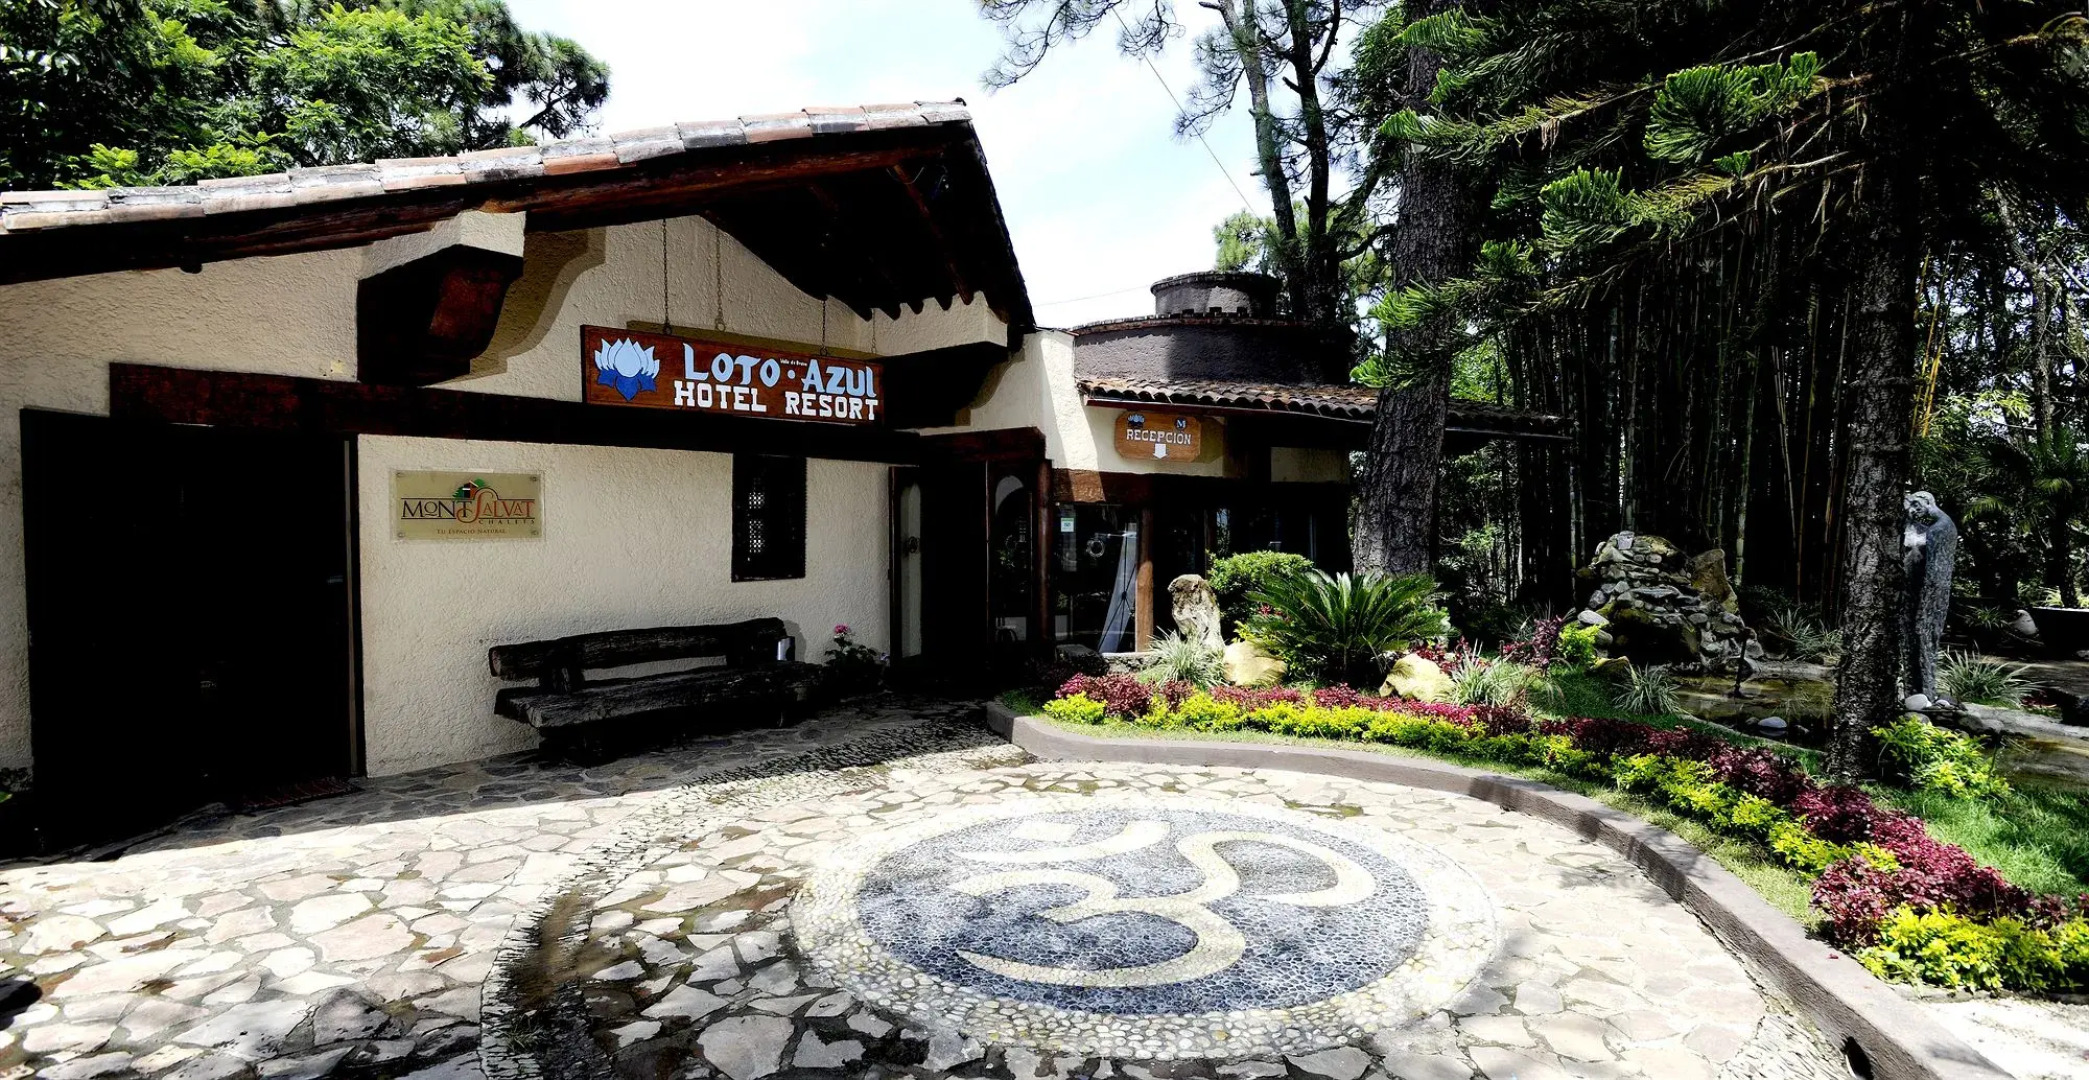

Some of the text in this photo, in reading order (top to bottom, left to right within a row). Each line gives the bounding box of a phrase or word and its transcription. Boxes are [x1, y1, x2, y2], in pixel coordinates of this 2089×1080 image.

[683, 342, 781, 388] LOTO
[674, 380, 879, 421] HOTEL RESORT
